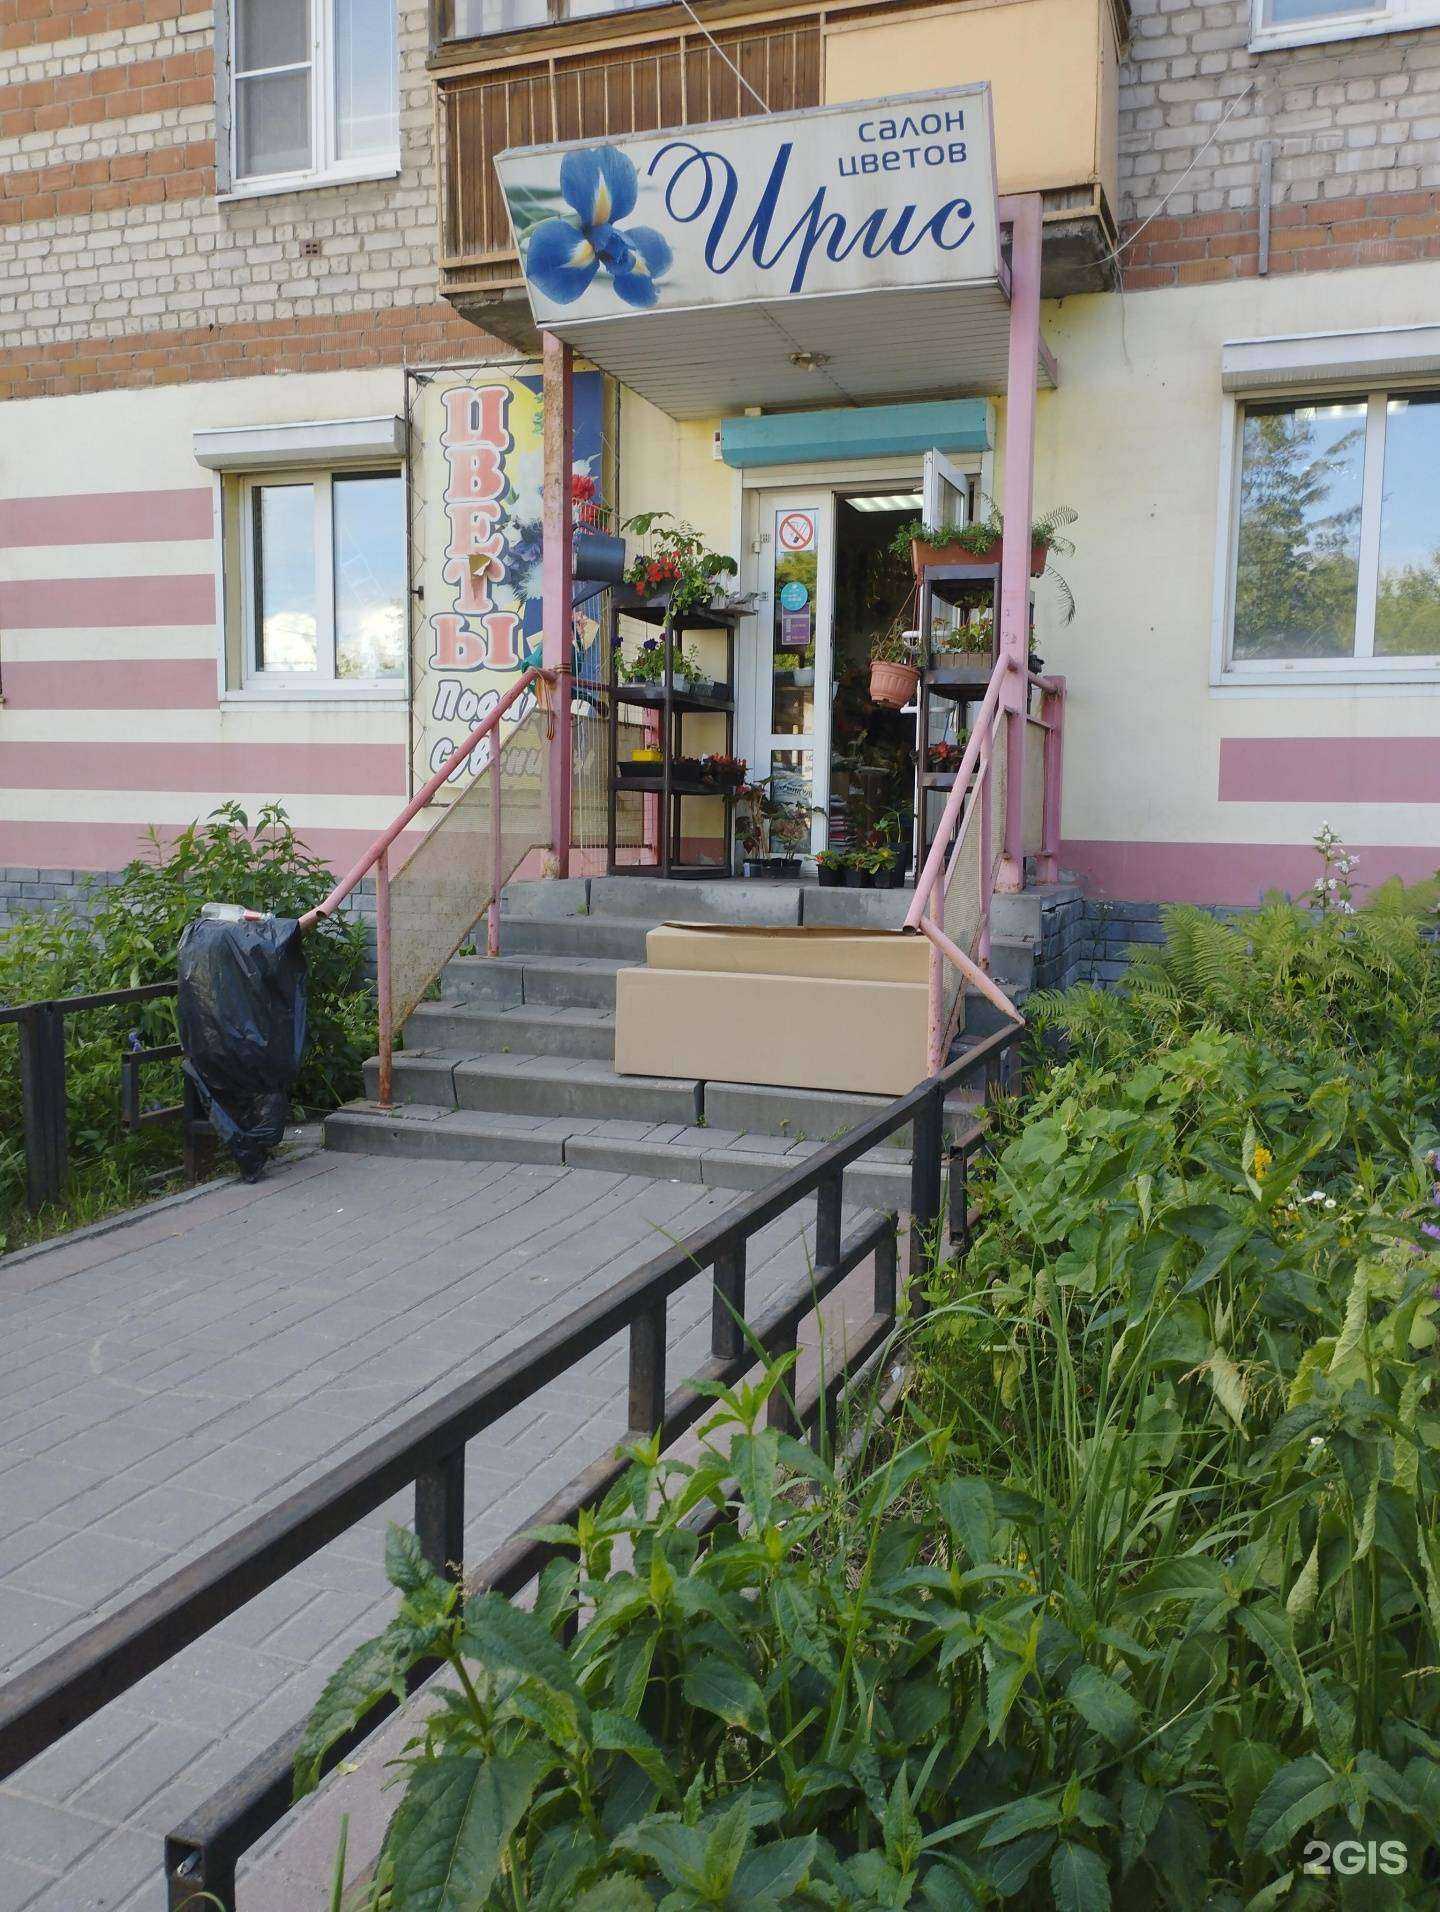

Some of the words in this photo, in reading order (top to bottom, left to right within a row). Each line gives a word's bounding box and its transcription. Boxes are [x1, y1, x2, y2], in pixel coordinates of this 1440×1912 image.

[857, 109, 965, 143] салон
[837, 141, 968, 177] цветов
[647, 141, 975, 293] Ирис
[429, 384, 523, 674] ЦВЕТЫ
[429, 736, 597, 783] Свниы
